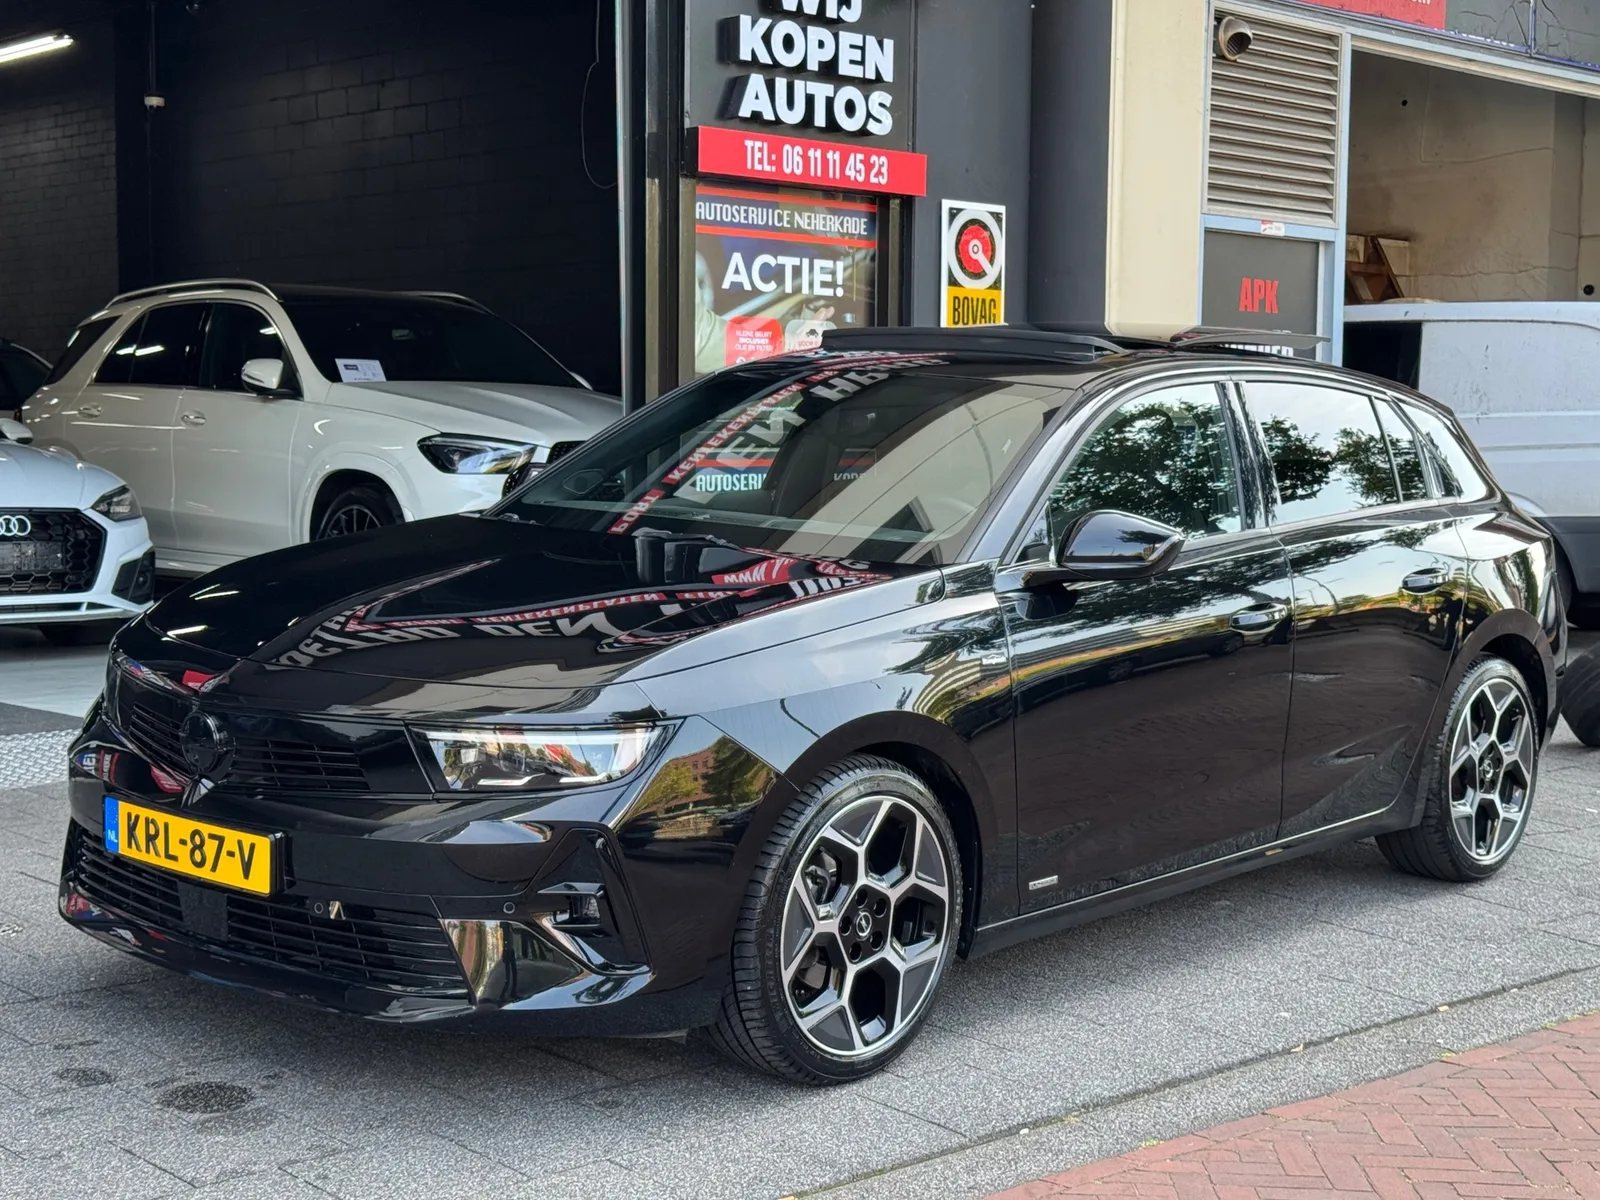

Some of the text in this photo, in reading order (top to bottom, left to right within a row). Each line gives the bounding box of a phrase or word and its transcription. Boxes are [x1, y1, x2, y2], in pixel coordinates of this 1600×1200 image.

[739, 14, 894, 83] KOPEN
[738, 73, 893, 135] AUTOS
[744, 139, 889, 185] TEL: 06 11 11 45 23
[695, 201, 868, 236] AUTOSERVICE NEHERKADE
[721, 252, 844, 298] ACTIE!
[1238, 277, 1279, 314] APK
[952, 295, 997, 326] BOVAG
[107, 828, 119, 844] NL
[126, 811, 256, 881] KRL-87-V
